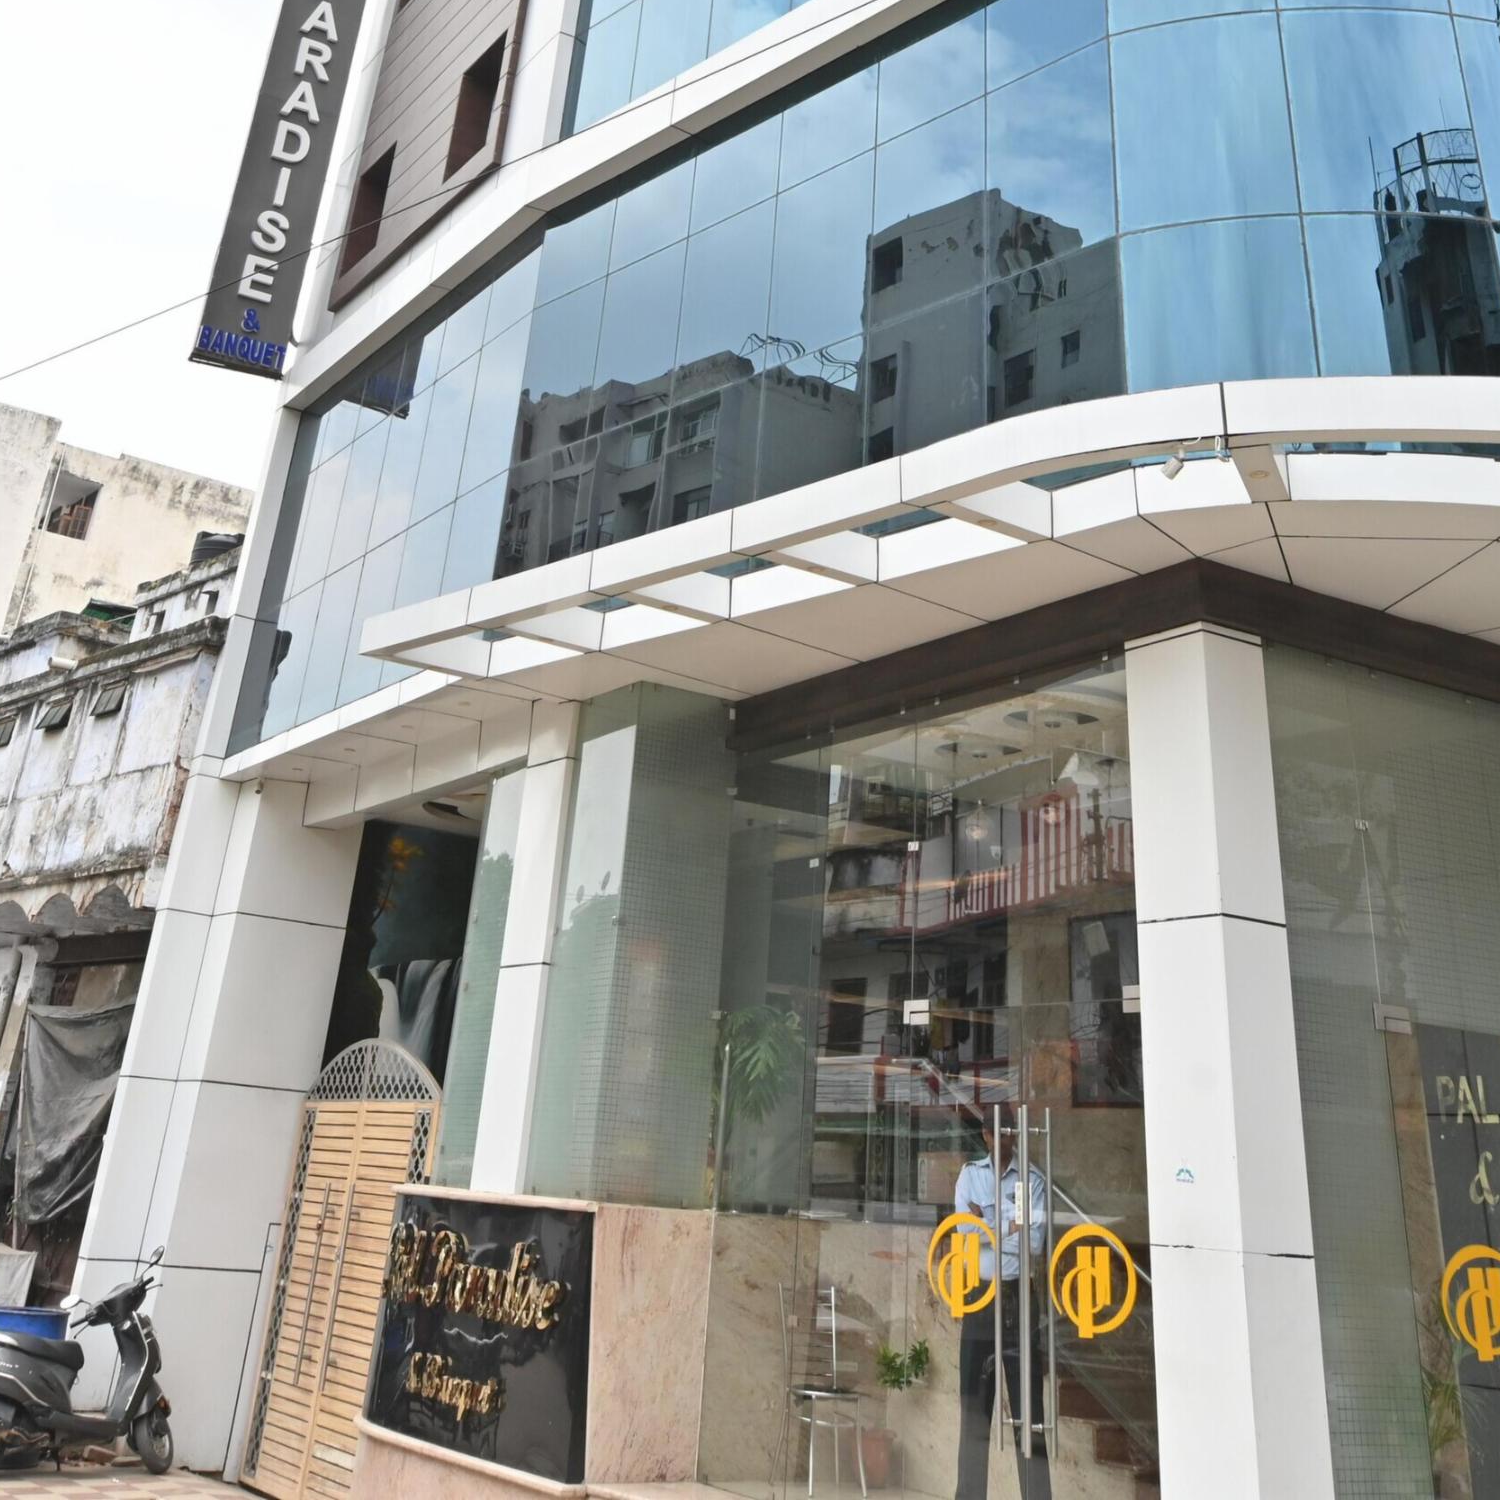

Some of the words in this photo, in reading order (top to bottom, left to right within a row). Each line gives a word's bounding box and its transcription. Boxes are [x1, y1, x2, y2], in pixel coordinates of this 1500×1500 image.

[241, 308, 260, 332] &
[196, 325, 287, 370] BANQUET
[1435, 1075, 1500, 1124] PAL
